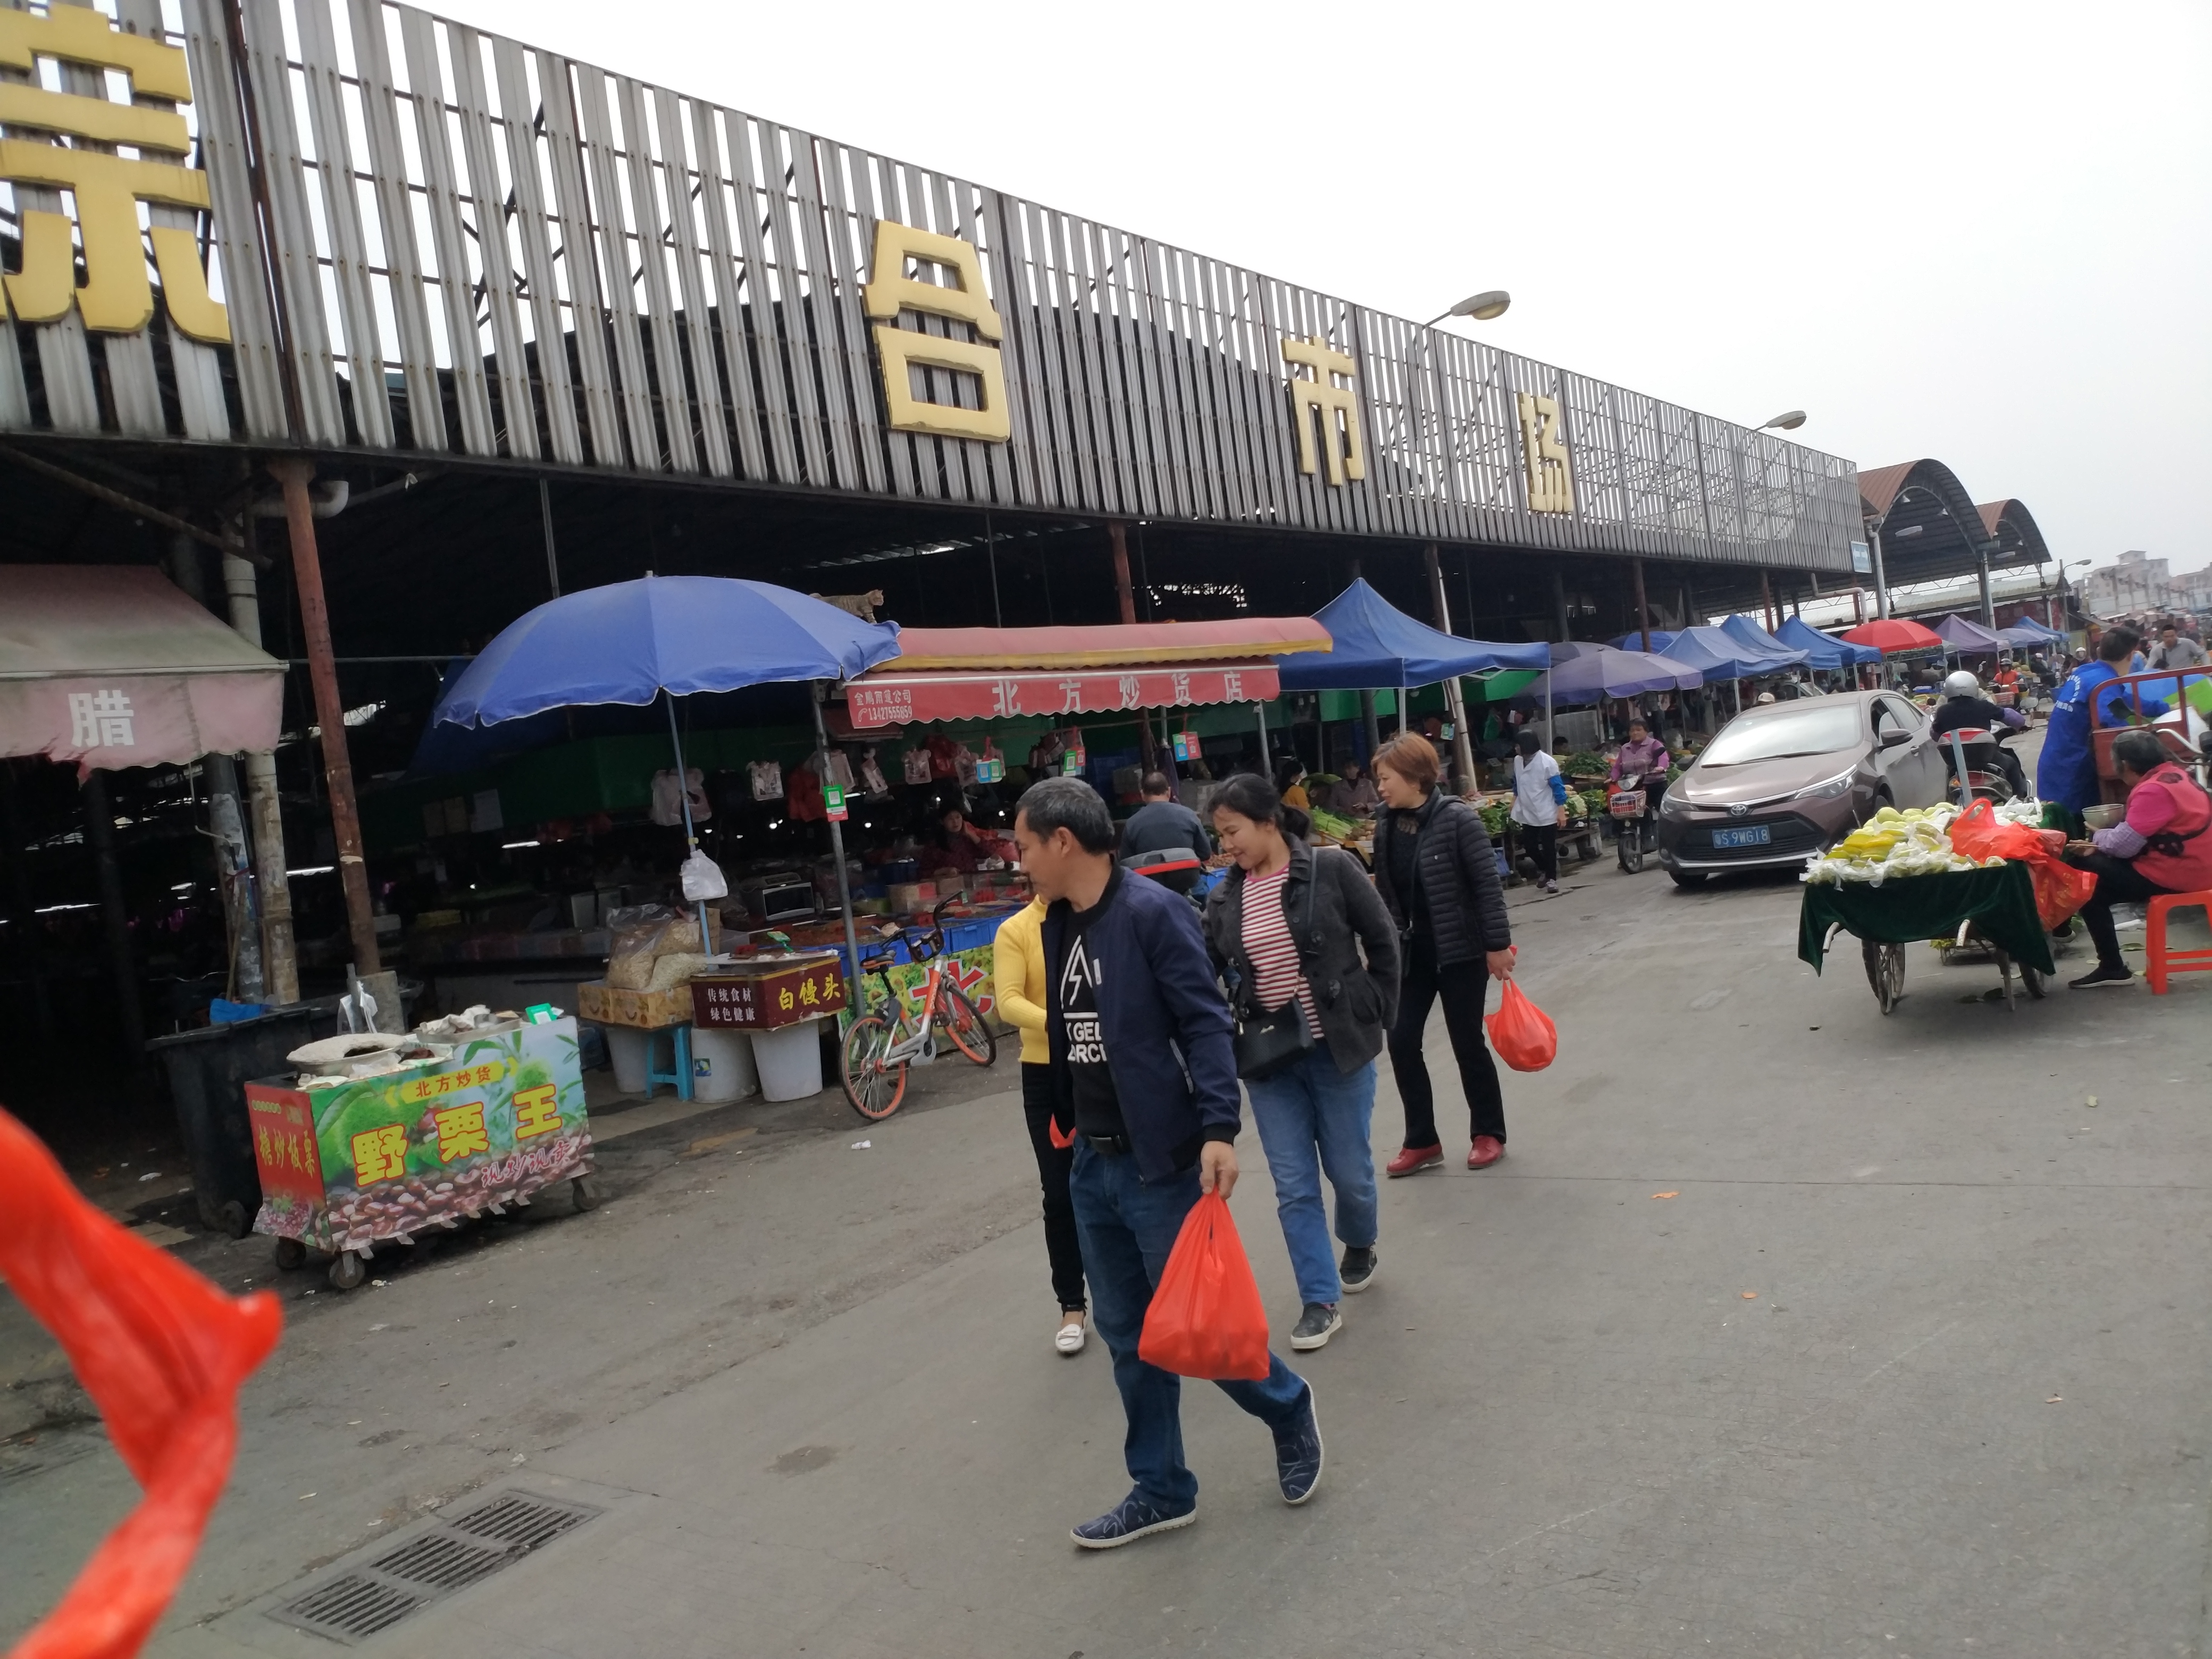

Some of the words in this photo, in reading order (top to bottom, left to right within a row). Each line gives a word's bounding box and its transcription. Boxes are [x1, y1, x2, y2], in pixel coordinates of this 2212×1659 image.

[992, 671, 1243, 716] 北方炒货店
[68, 690, 136, 748] 腊
[868, 705, 912, 720] 13427555859
[707, 987, 752, 1003] 传统食材
[778, 973, 841, 1010] 白馒头
[710, 1007, 756, 1022] 绿色健康
[415, 1066, 491, 1098] 北方炒货
[350, 1083, 563, 1188] 野栗王
